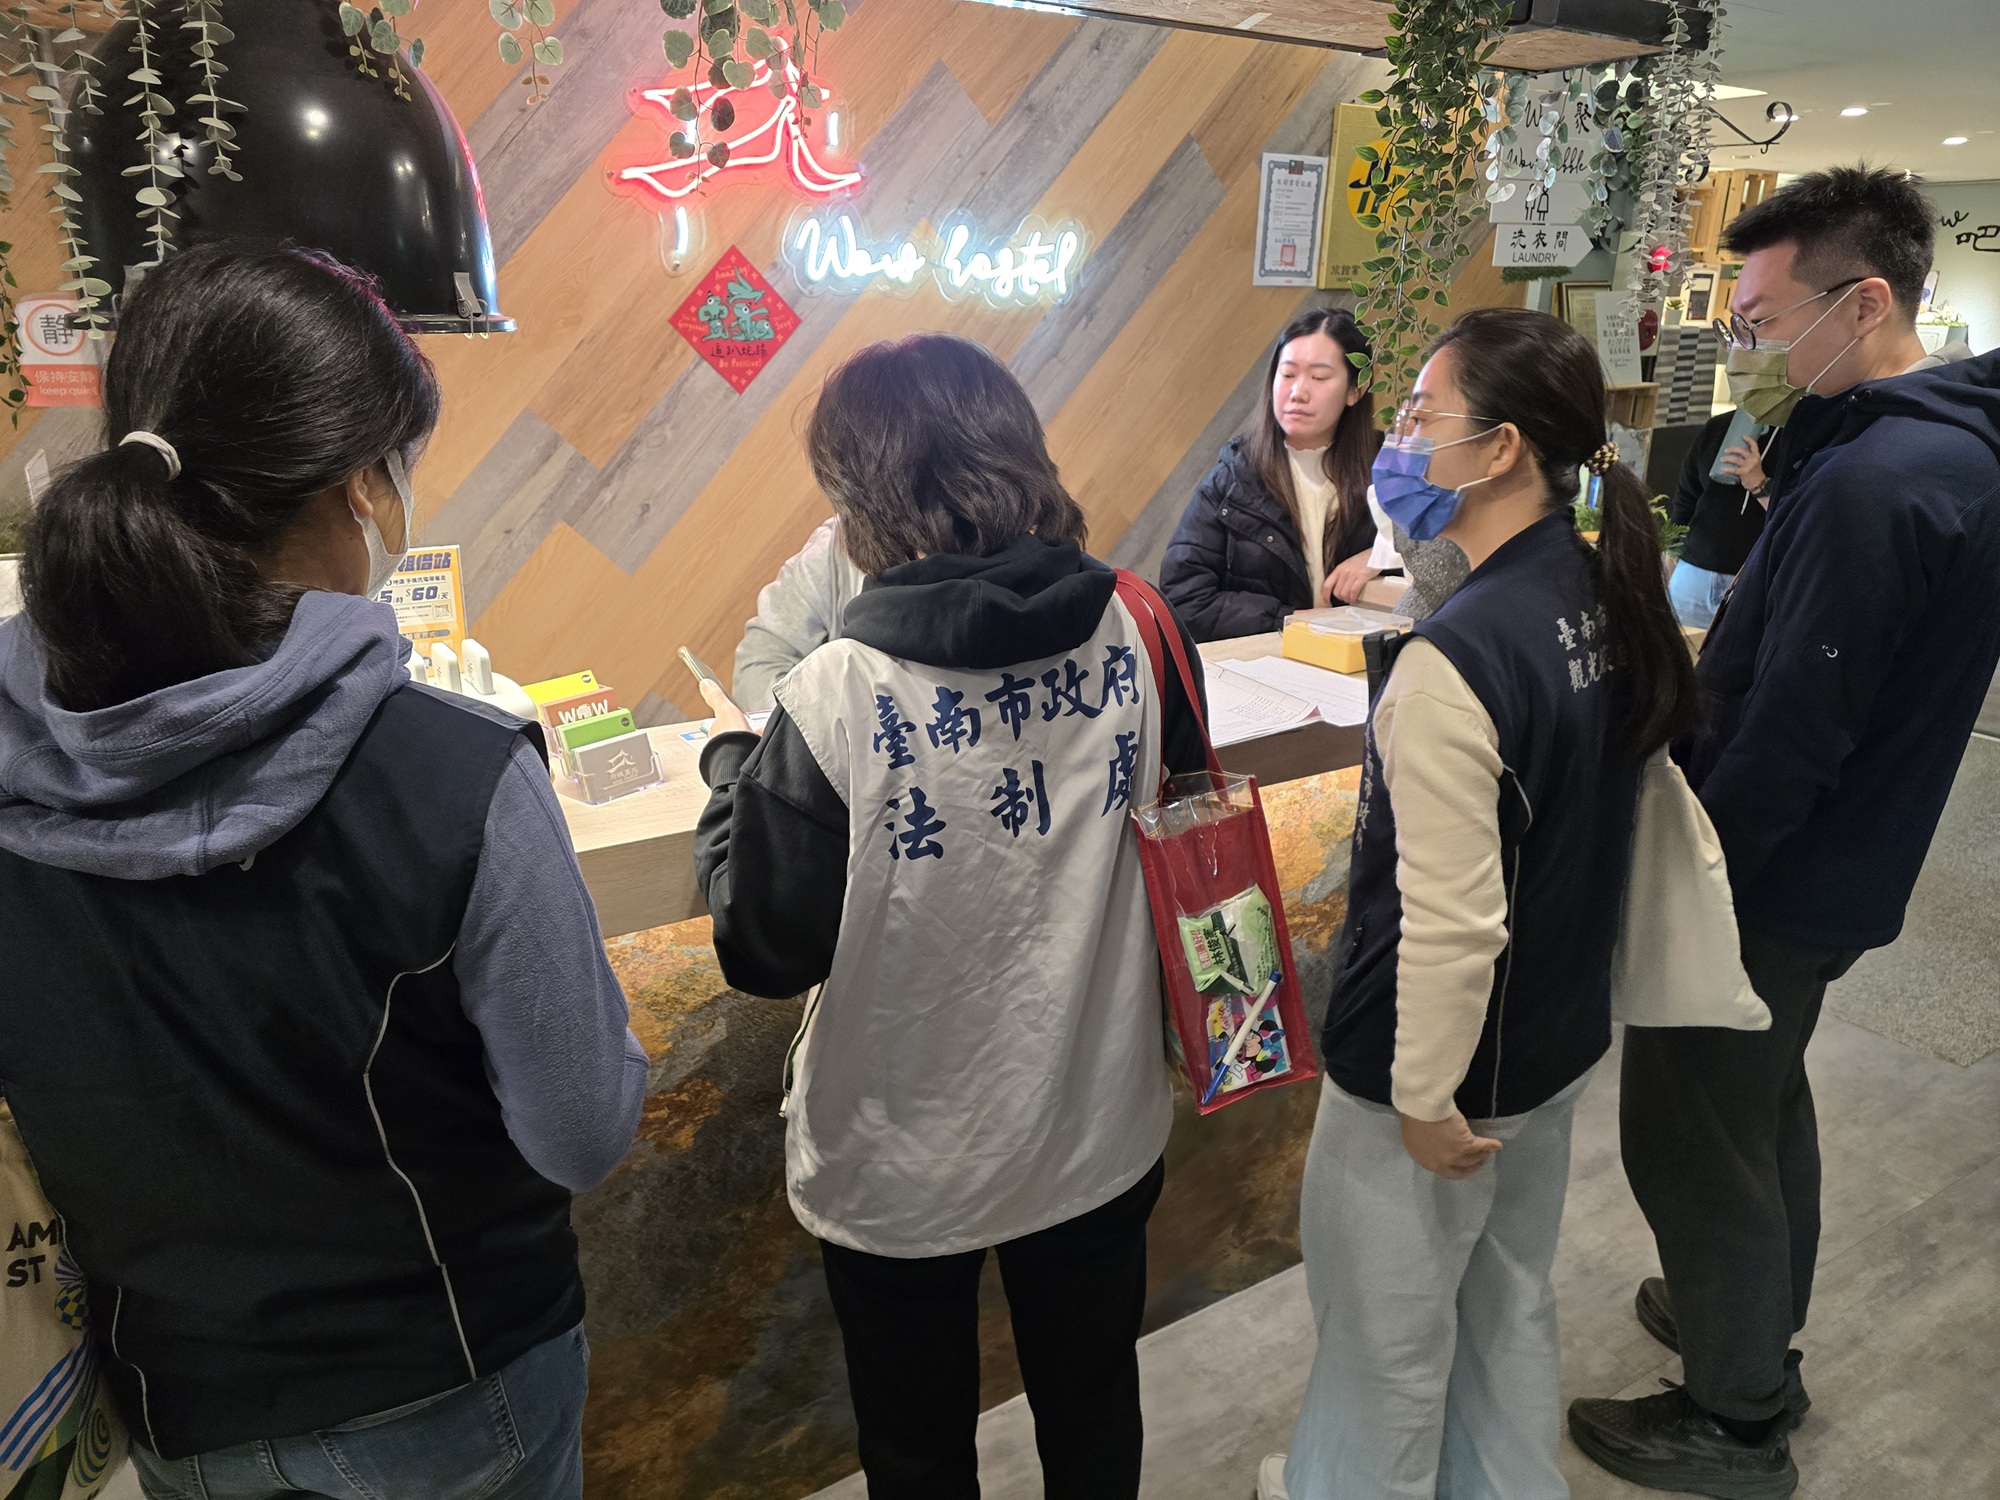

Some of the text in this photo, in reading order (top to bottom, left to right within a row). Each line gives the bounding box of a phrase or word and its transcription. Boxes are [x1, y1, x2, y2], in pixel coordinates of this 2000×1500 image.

[1510, 228, 1569, 252] 洗衣間
[943, 223, 1079, 298] hostel
[1512, 252, 1558, 264] LAUNDRY
[40, 386, 67, 397] keep
[873, 645, 1140, 770] 臺南市政府
[884, 731, 1140, 861] 法制處
[6, 1254, 46, 1288] ST
